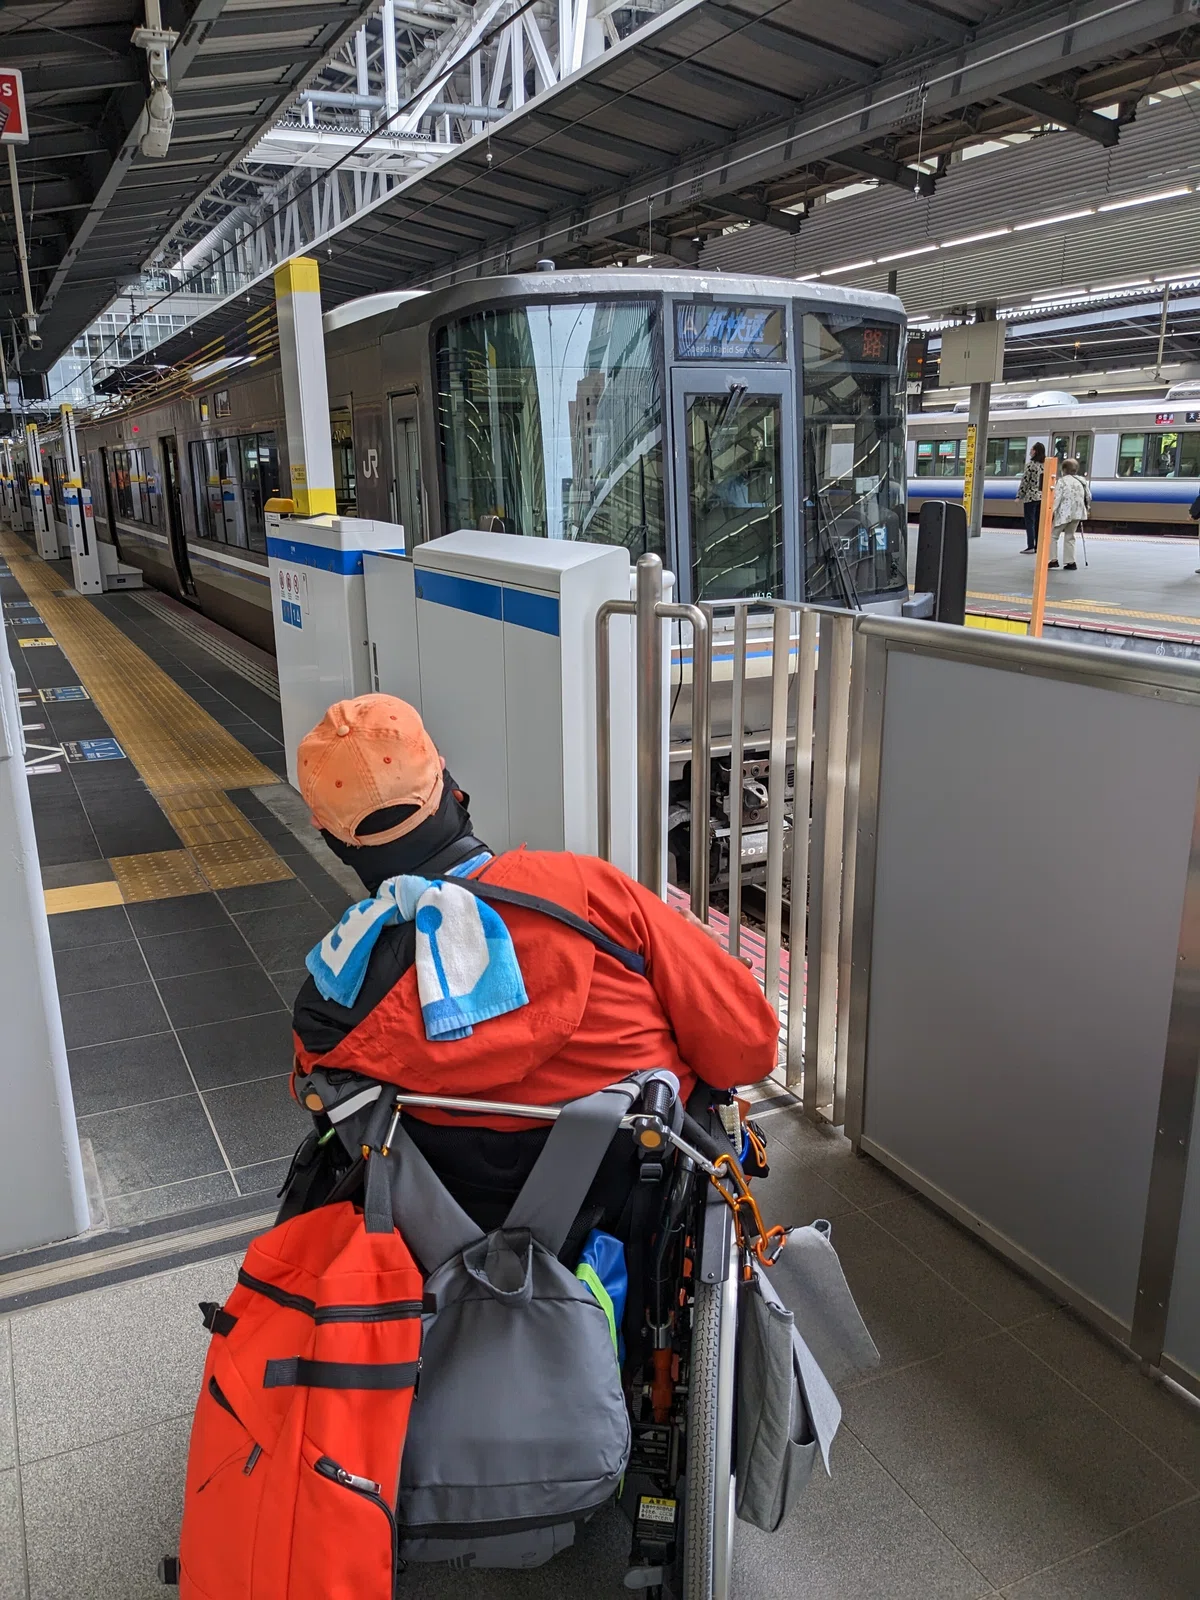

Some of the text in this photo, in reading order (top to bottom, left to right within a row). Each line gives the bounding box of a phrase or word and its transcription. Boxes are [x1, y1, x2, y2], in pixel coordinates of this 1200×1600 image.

[705, 310, 765, 343] 新快速
[687, 345, 760, 355] Special Rapid Service
[363, 449, 379, 479] JR
